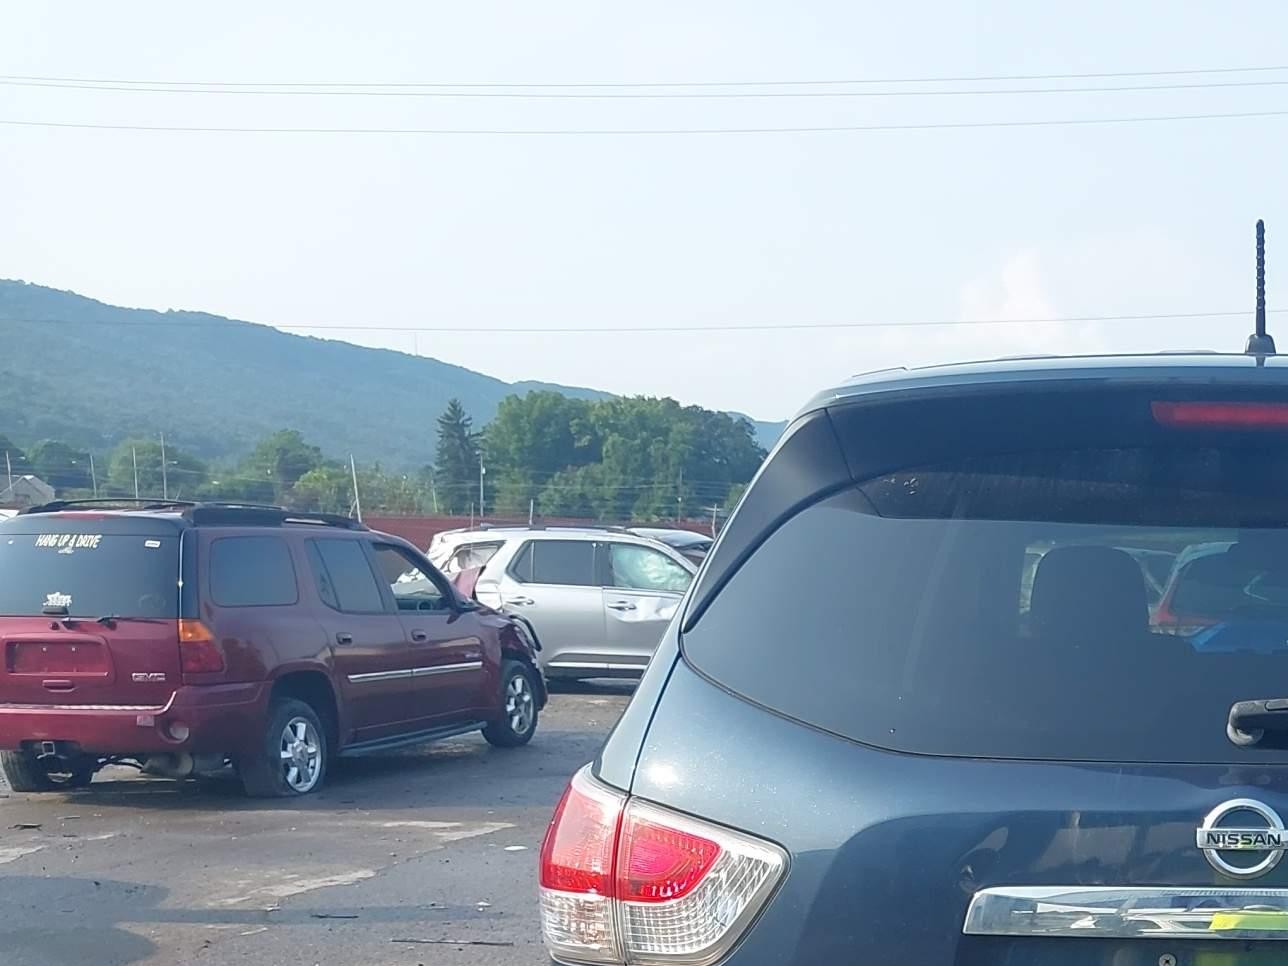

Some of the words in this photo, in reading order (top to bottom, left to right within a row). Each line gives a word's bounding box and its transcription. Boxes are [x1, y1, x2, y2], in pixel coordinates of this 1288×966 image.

[35, 534, 59, 547] HANG
[57, 534, 70, 547] UP
[76, 534, 103, 549] DRIVE
[131, 672, 166, 682] GMC
[1206, 833, 1281, 846] NISSAN
